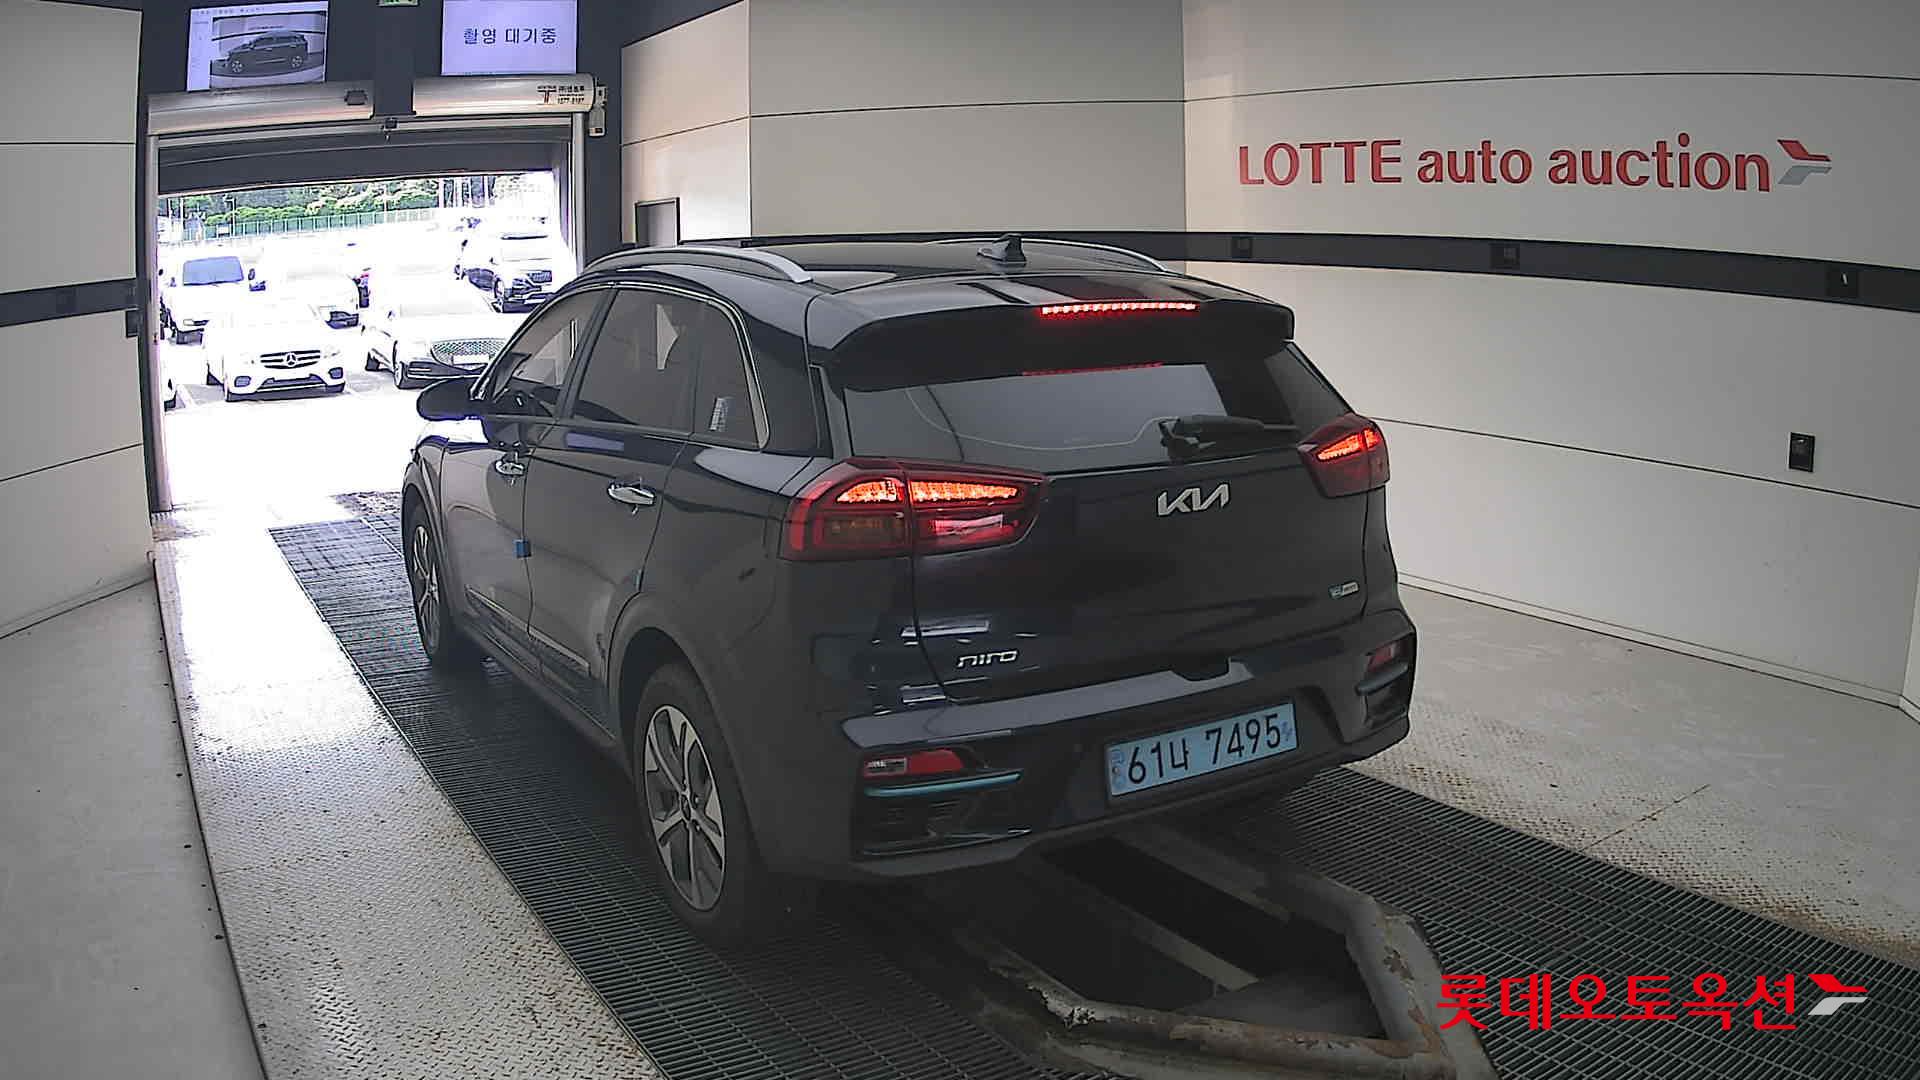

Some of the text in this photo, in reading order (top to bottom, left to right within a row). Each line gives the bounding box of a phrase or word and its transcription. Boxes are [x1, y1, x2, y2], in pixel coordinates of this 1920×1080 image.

[464, 28, 556, 45] 촬영 대기중
[1239, 132, 1770, 192] LOTTE auto auction
[1128, 713, 1281, 785] 61나 7495
